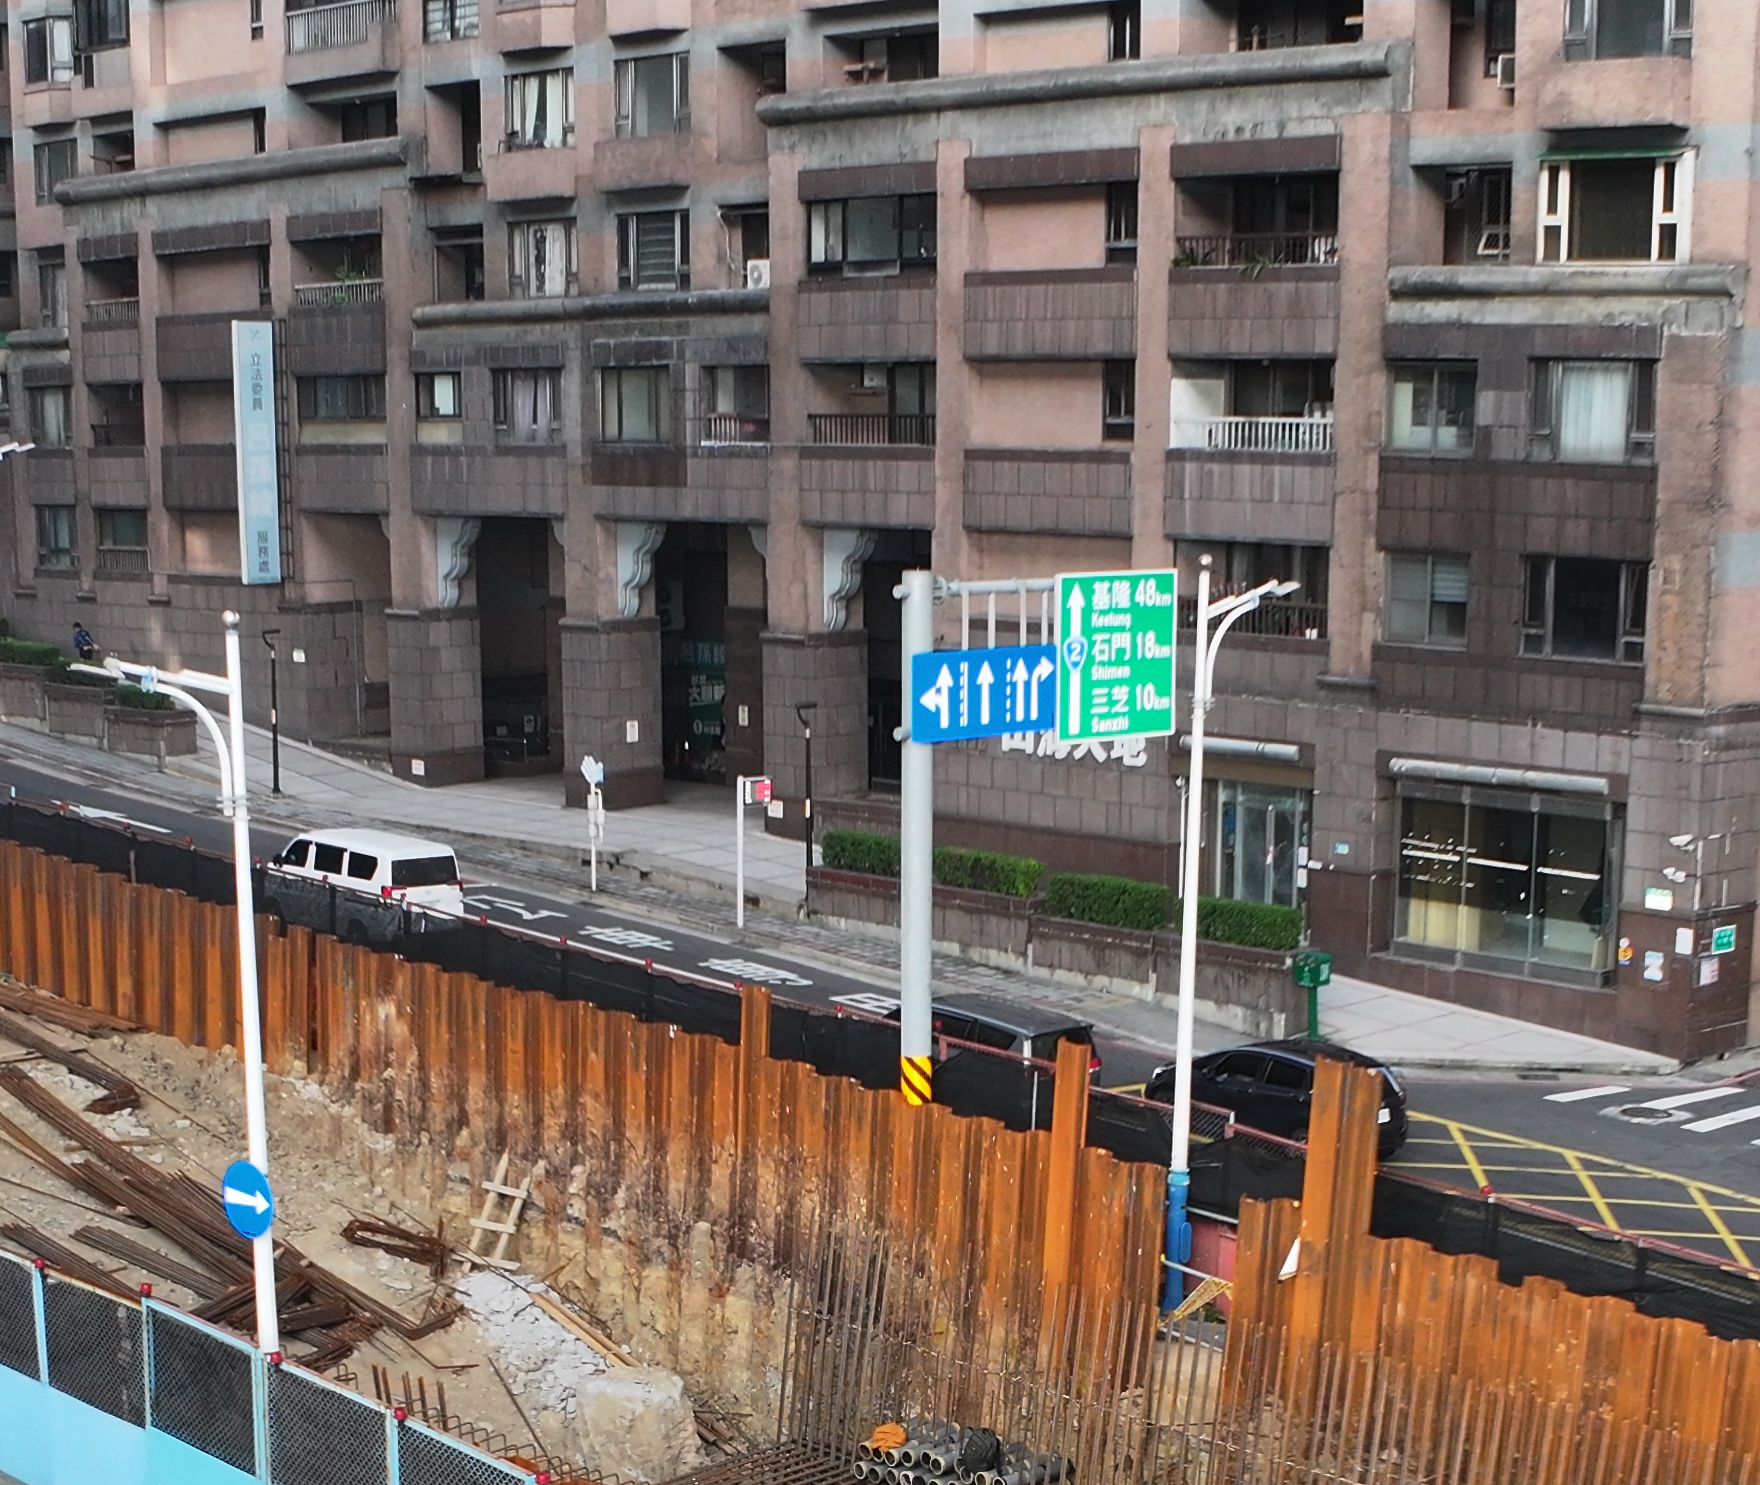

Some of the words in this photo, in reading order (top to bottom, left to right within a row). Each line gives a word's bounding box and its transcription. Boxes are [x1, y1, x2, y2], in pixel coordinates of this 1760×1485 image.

[250, 353, 264, 411] 立法委員
[1092, 580, 1131, 611] 基隆
[1091, 611, 1132, 630] Keelung
[1070, 642, 1081, 662] 2
[1091, 631, 1131, 663] 石門
[1091, 665, 1131, 681] Shimen
[1091, 685, 1130, 714] 三芝
[1091, 715, 1129, 733] Sanzhi
